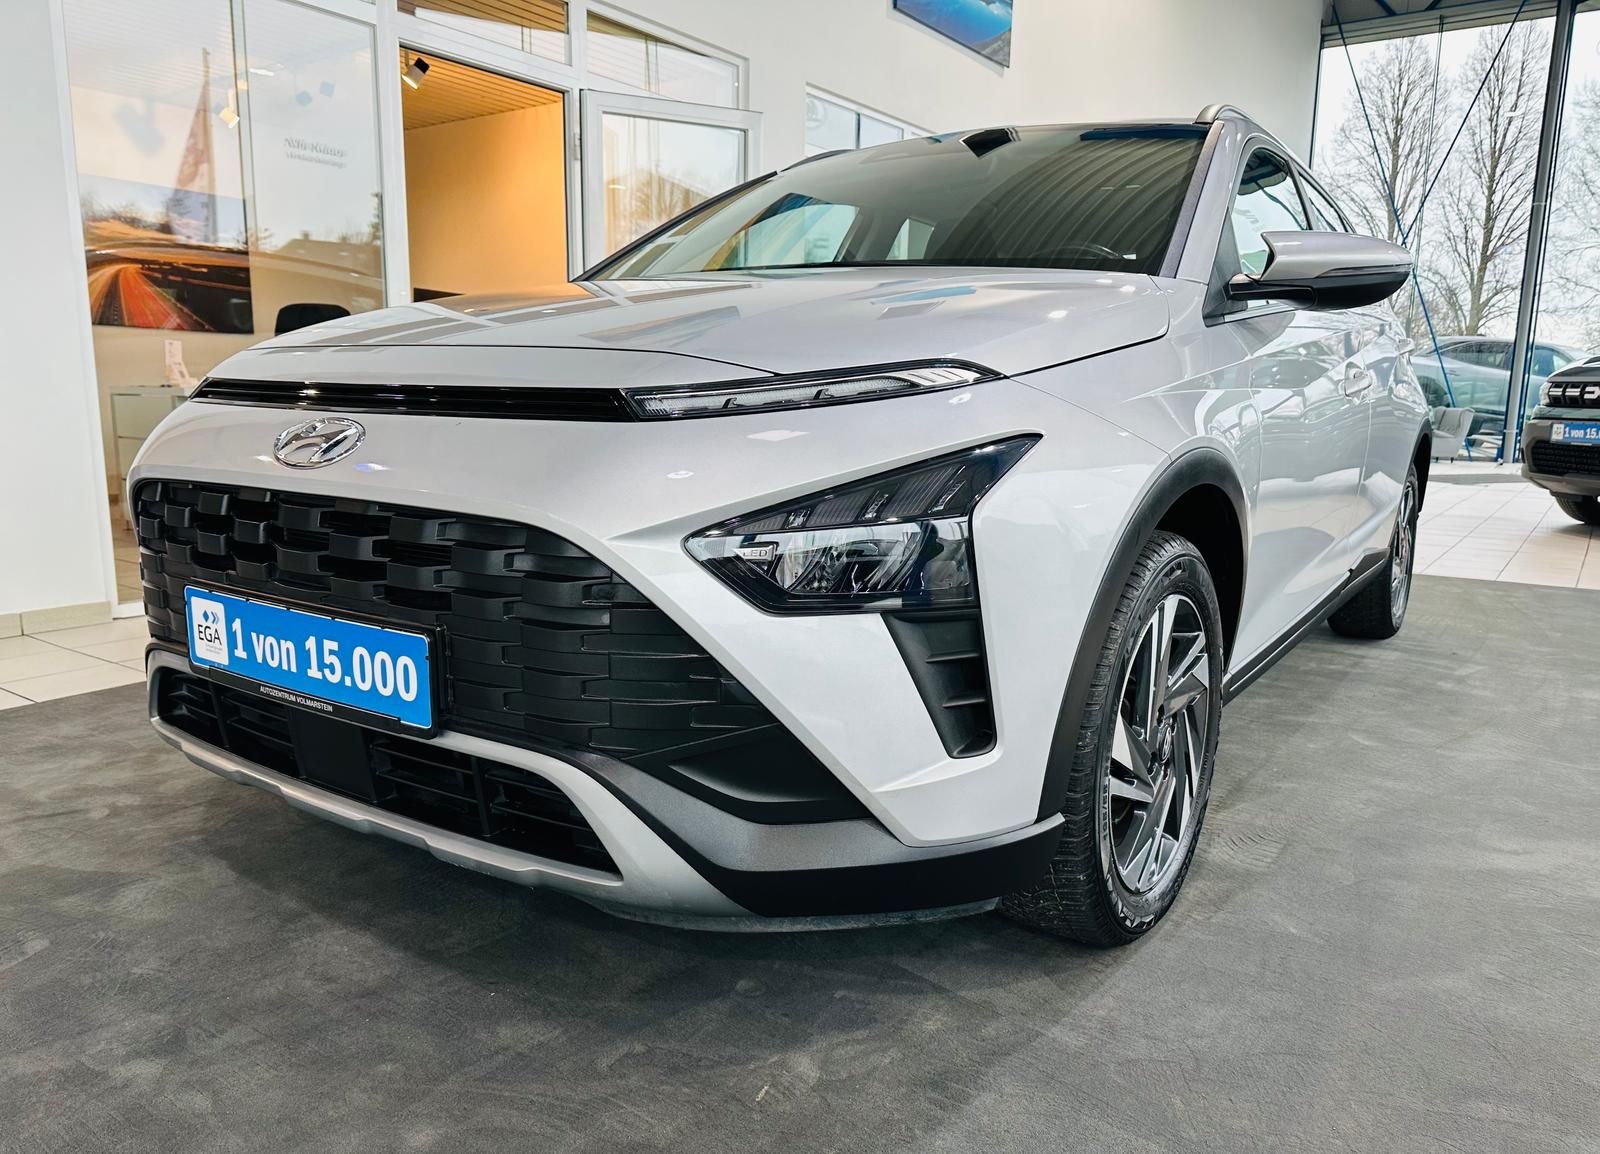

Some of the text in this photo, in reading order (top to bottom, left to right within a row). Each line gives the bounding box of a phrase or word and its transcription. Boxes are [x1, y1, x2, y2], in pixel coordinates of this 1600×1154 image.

[1564, 426, 1569, 438] 1
[743, 549, 768, 557] LED
[197, 623, 222, 646] EGA
[231, 617, 418, 702] 1 von 15.000
[260, 685, 333, 712] AUTOZENTRUM VOLMARSTEIN
